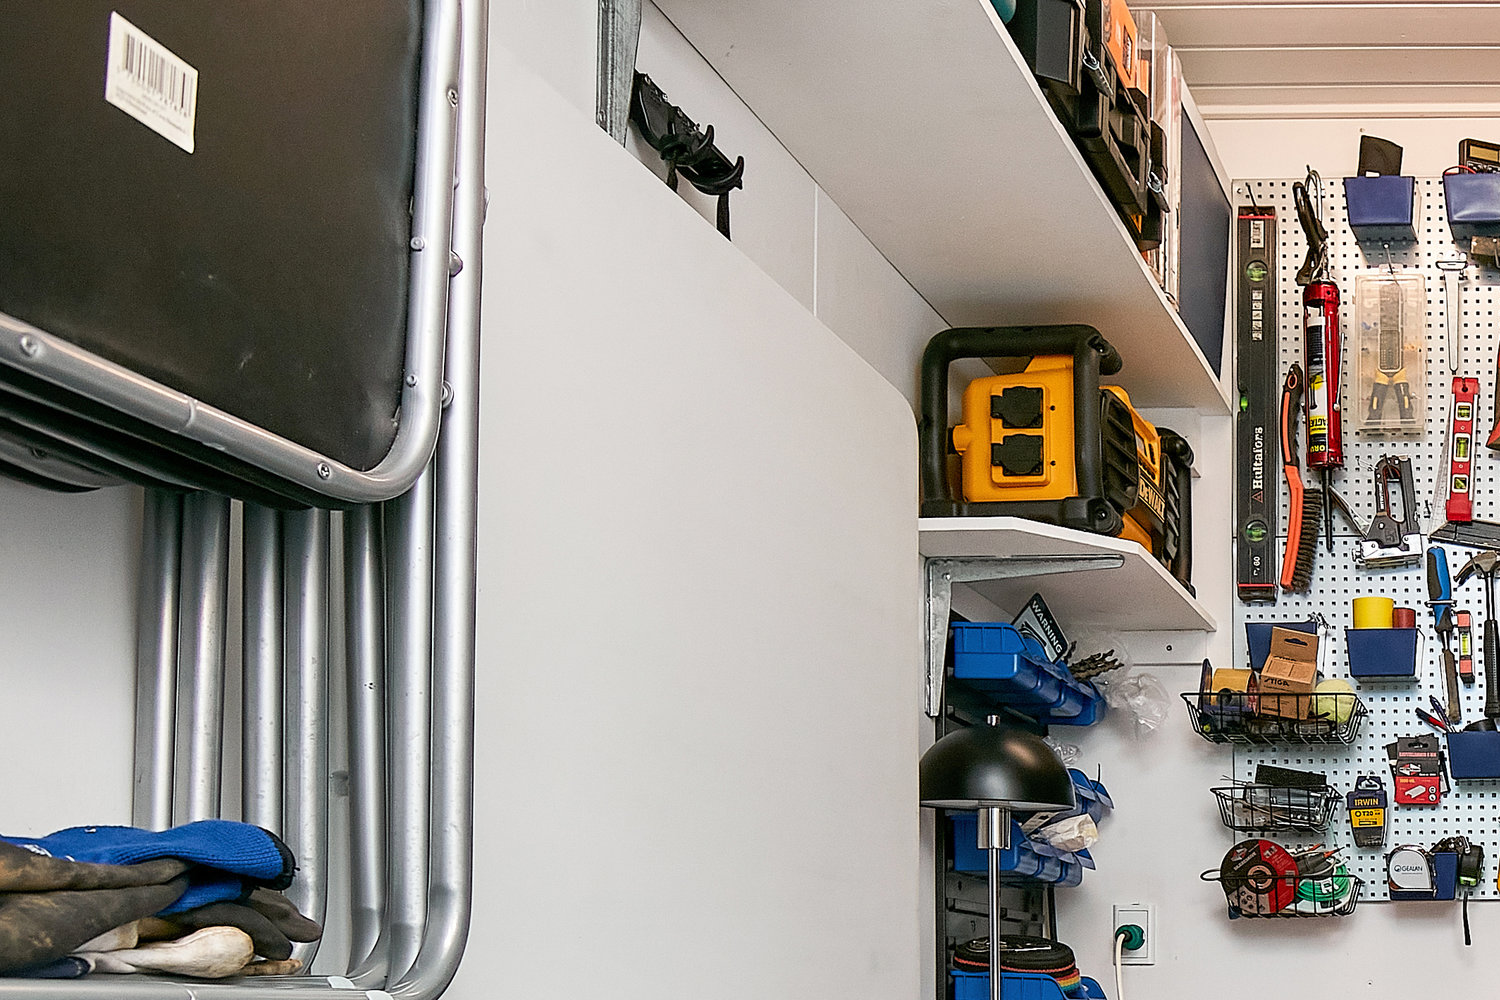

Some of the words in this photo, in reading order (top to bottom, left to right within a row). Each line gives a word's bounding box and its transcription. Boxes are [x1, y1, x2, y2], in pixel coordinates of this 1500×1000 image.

[1252, 426, 1264, 490] Hultafors
[1032, 600, 1063, 654] WARNING
[1264, 678, 1290, 687] STIGA
[1354, 798, 1379, 806] IRWIN
